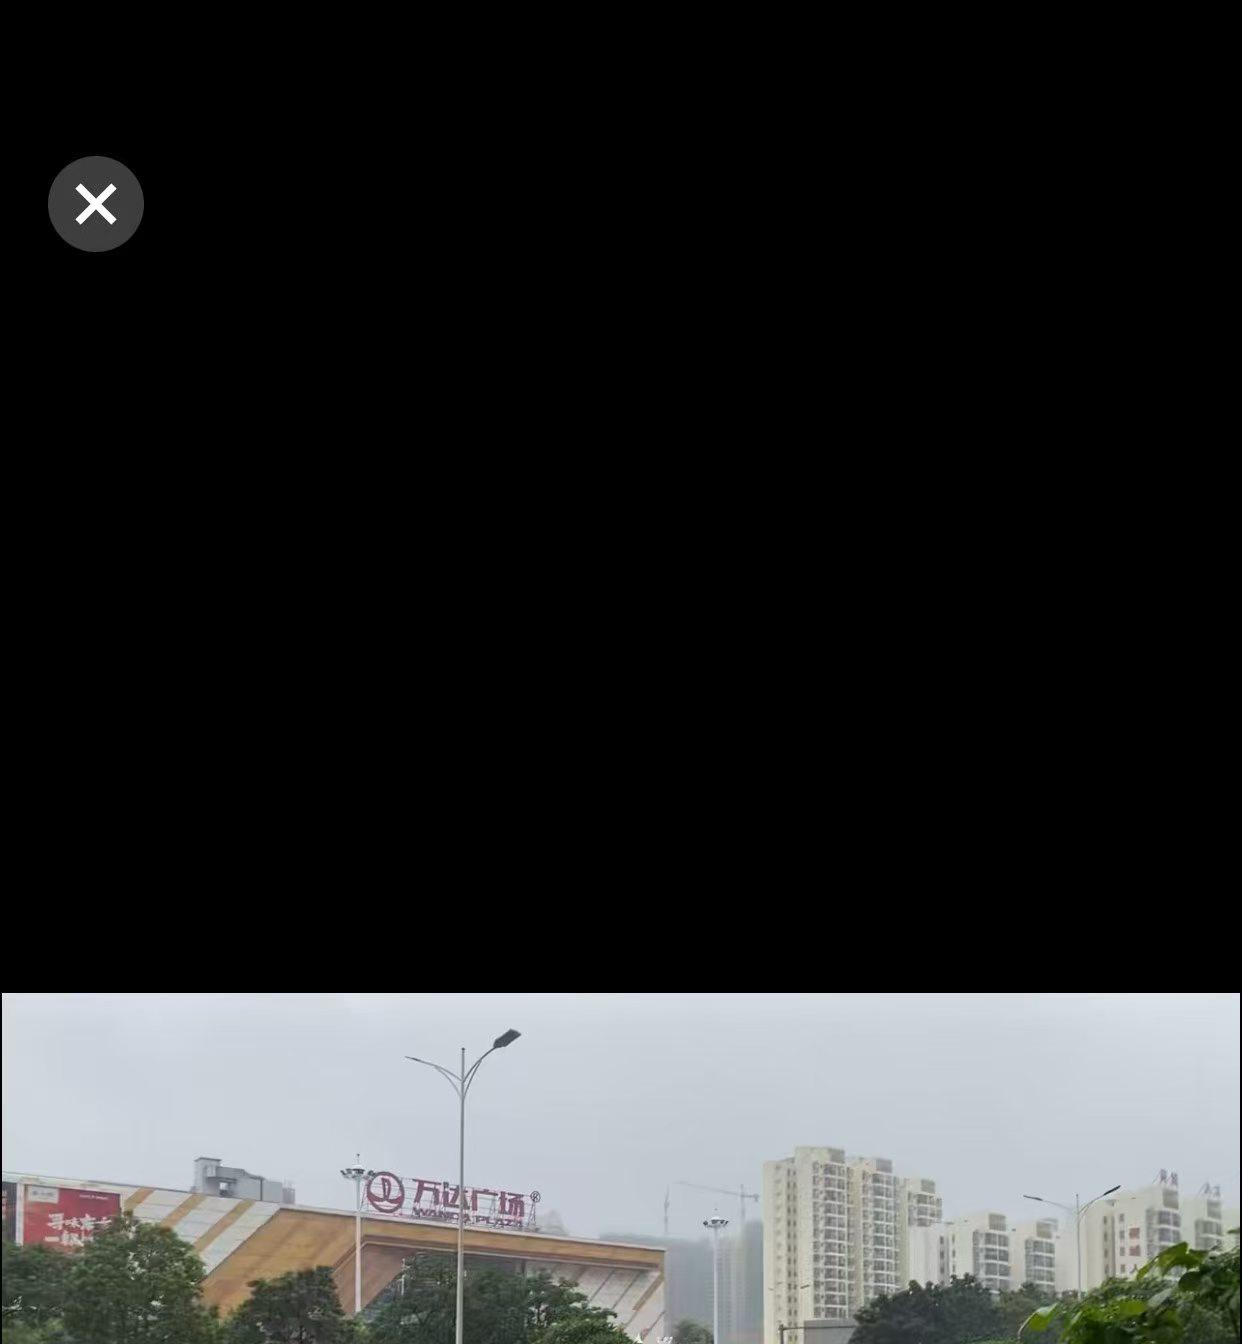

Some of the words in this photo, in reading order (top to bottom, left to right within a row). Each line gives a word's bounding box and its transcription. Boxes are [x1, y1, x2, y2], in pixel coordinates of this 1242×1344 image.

[413, 1179, 525, 1218] 万达广场
[413, 1206, 473, 1224] WANDA
